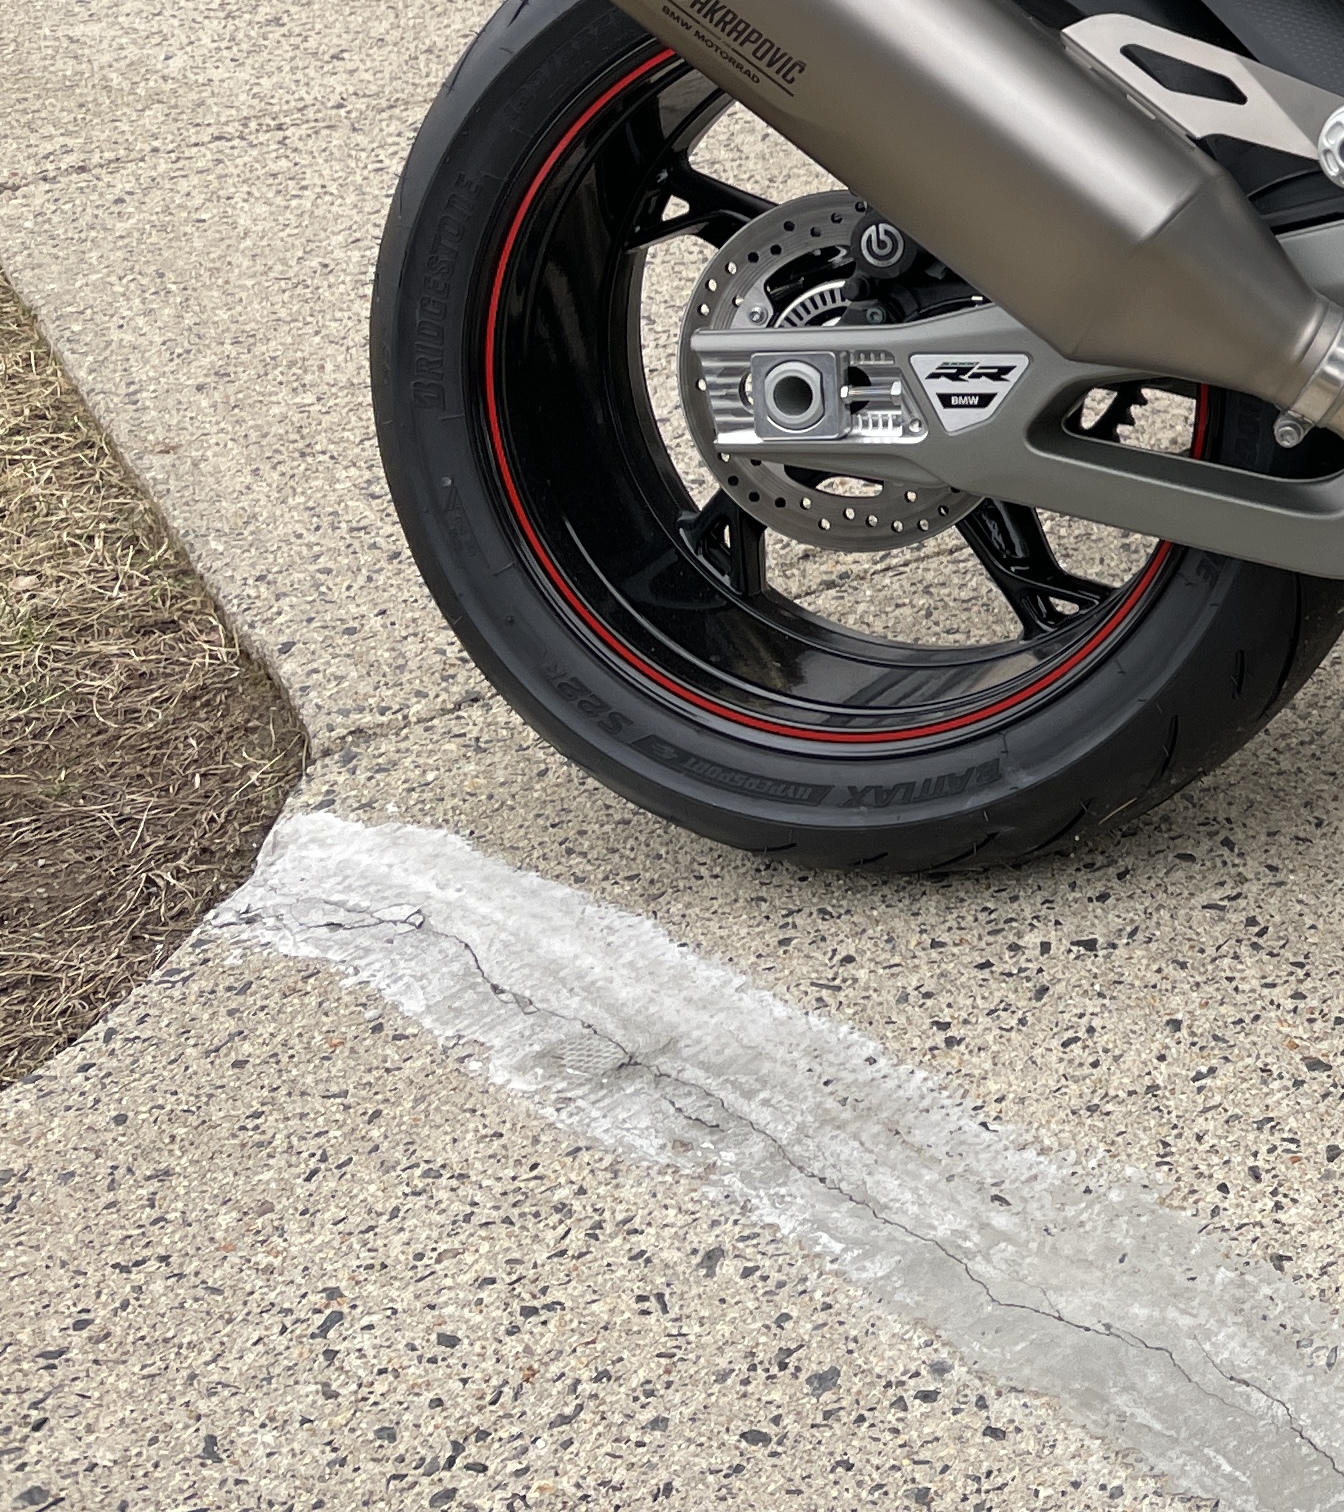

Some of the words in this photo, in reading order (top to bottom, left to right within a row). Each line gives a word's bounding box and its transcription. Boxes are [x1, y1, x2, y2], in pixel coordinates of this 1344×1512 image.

[661, 5, 692, 31] BMW
[693, 30, 761, 84] MOTORRAD
[411, 172, 480, 410] BRIDGESTONE
[925, 365, 1017, 383] RR
[951, 395, 979, 405] BMW
[837, 757, 1002, 808] BATTLAX
